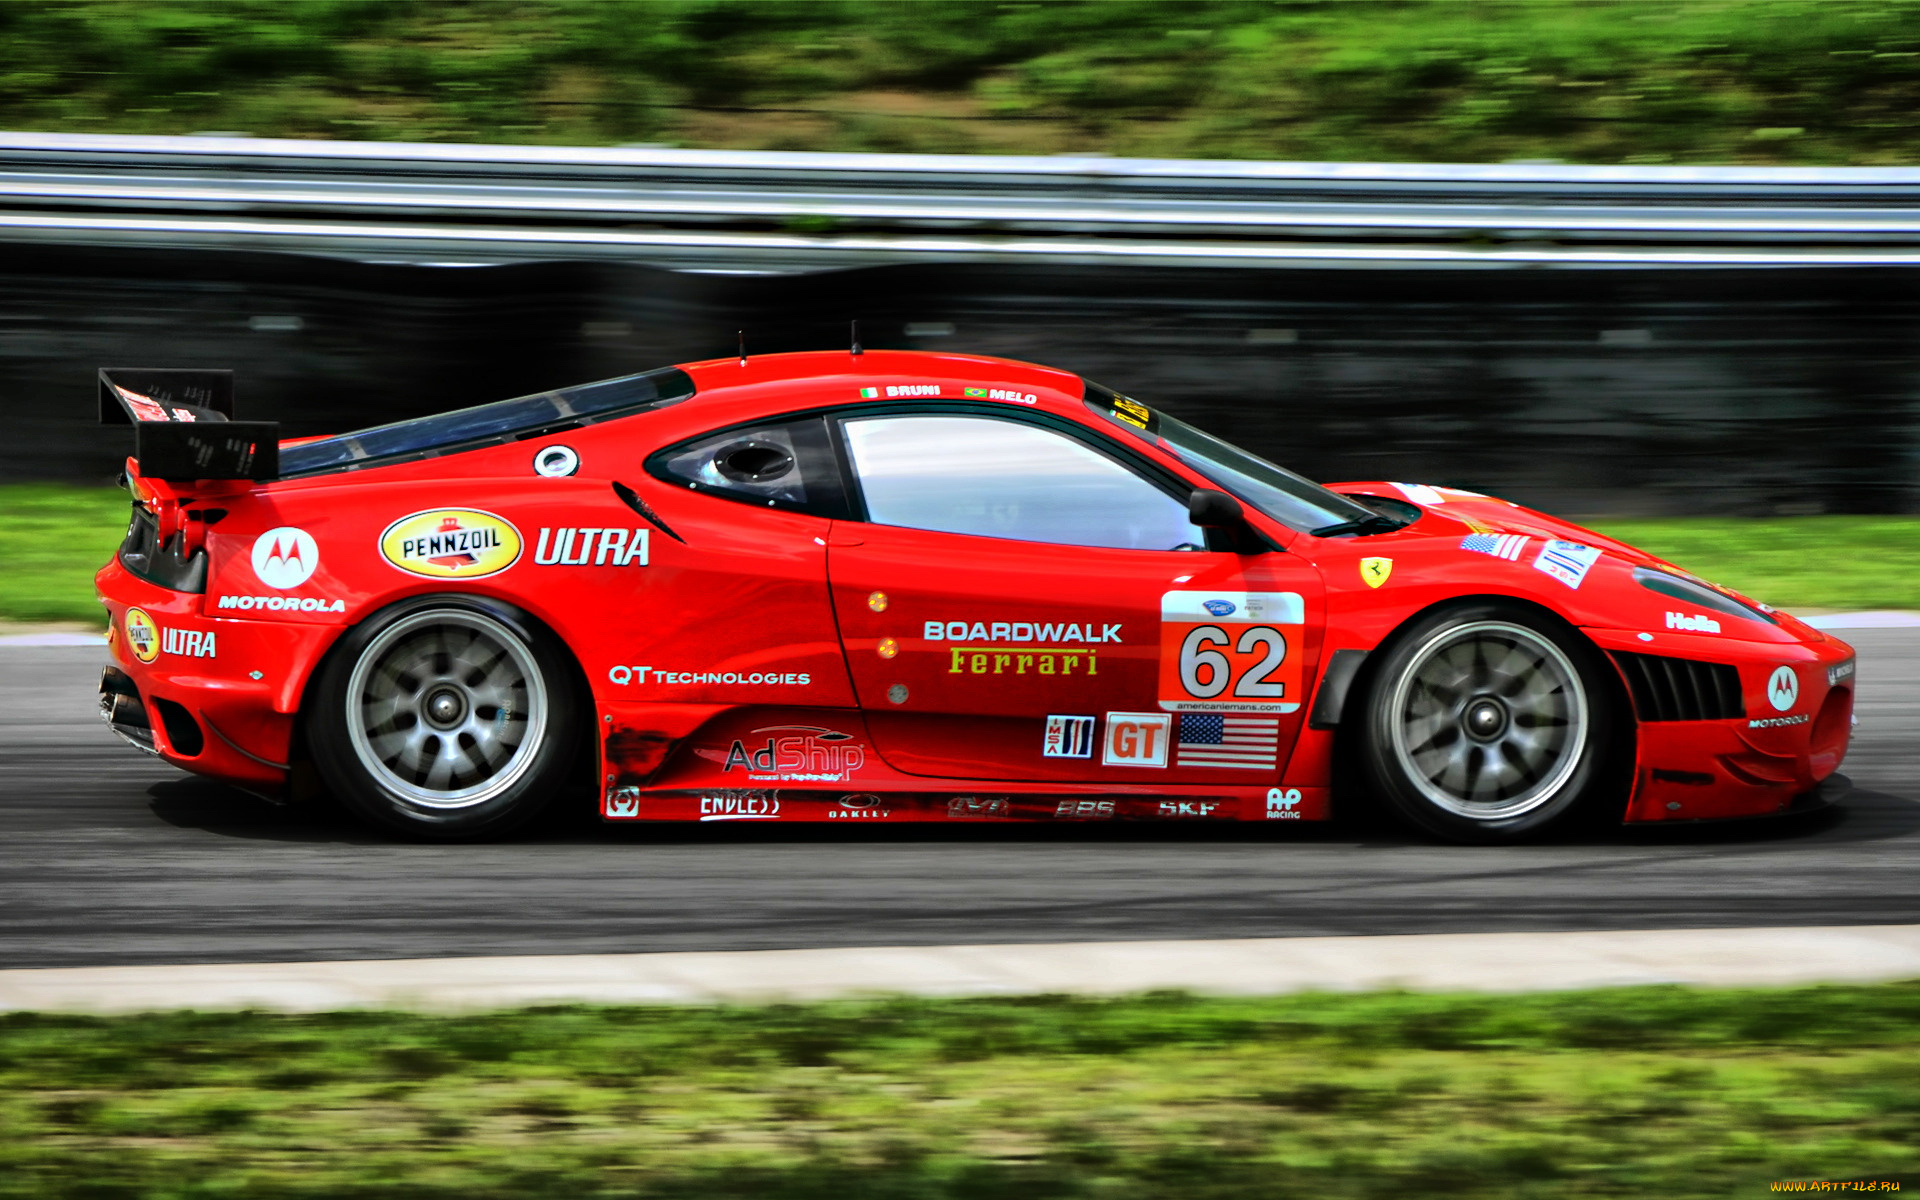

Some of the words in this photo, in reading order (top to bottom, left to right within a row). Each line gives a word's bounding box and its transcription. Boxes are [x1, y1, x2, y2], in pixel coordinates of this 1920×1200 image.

[886, 385, 940, 397] BRUNI
[989, 389, 1037, 405] MELO
[403, 534, 502, 558] PENNZOIL
[534, 527, 649, 567] ULTRA
[218, 595, 346, 613] MOTOROLA
[162, 627, 216, 658] ULTRA
[923, 621, 1123, 643] BOARDWALK
[948, 647, 1098, 675] Ferrari
[1179, 625, 1287, 699] 62
[608, 665, 652, 685] QT
[652, 670, 811, 685] TECHNOLOGIES
[1177, 703, 1282, 711] americanlemans.com
[1749, 714, 1809, 728] MOTOROLA
[1112, 722, 1163, 759] GT
[723, 736, 864, 781] AdShip
[700, 789, 780, 814] ENDLESS
[1158, 801, 1220, 816] SKF
[829, 810, 890, 818] OAKLEY
[1267, 811, 1301, 819] RACING
